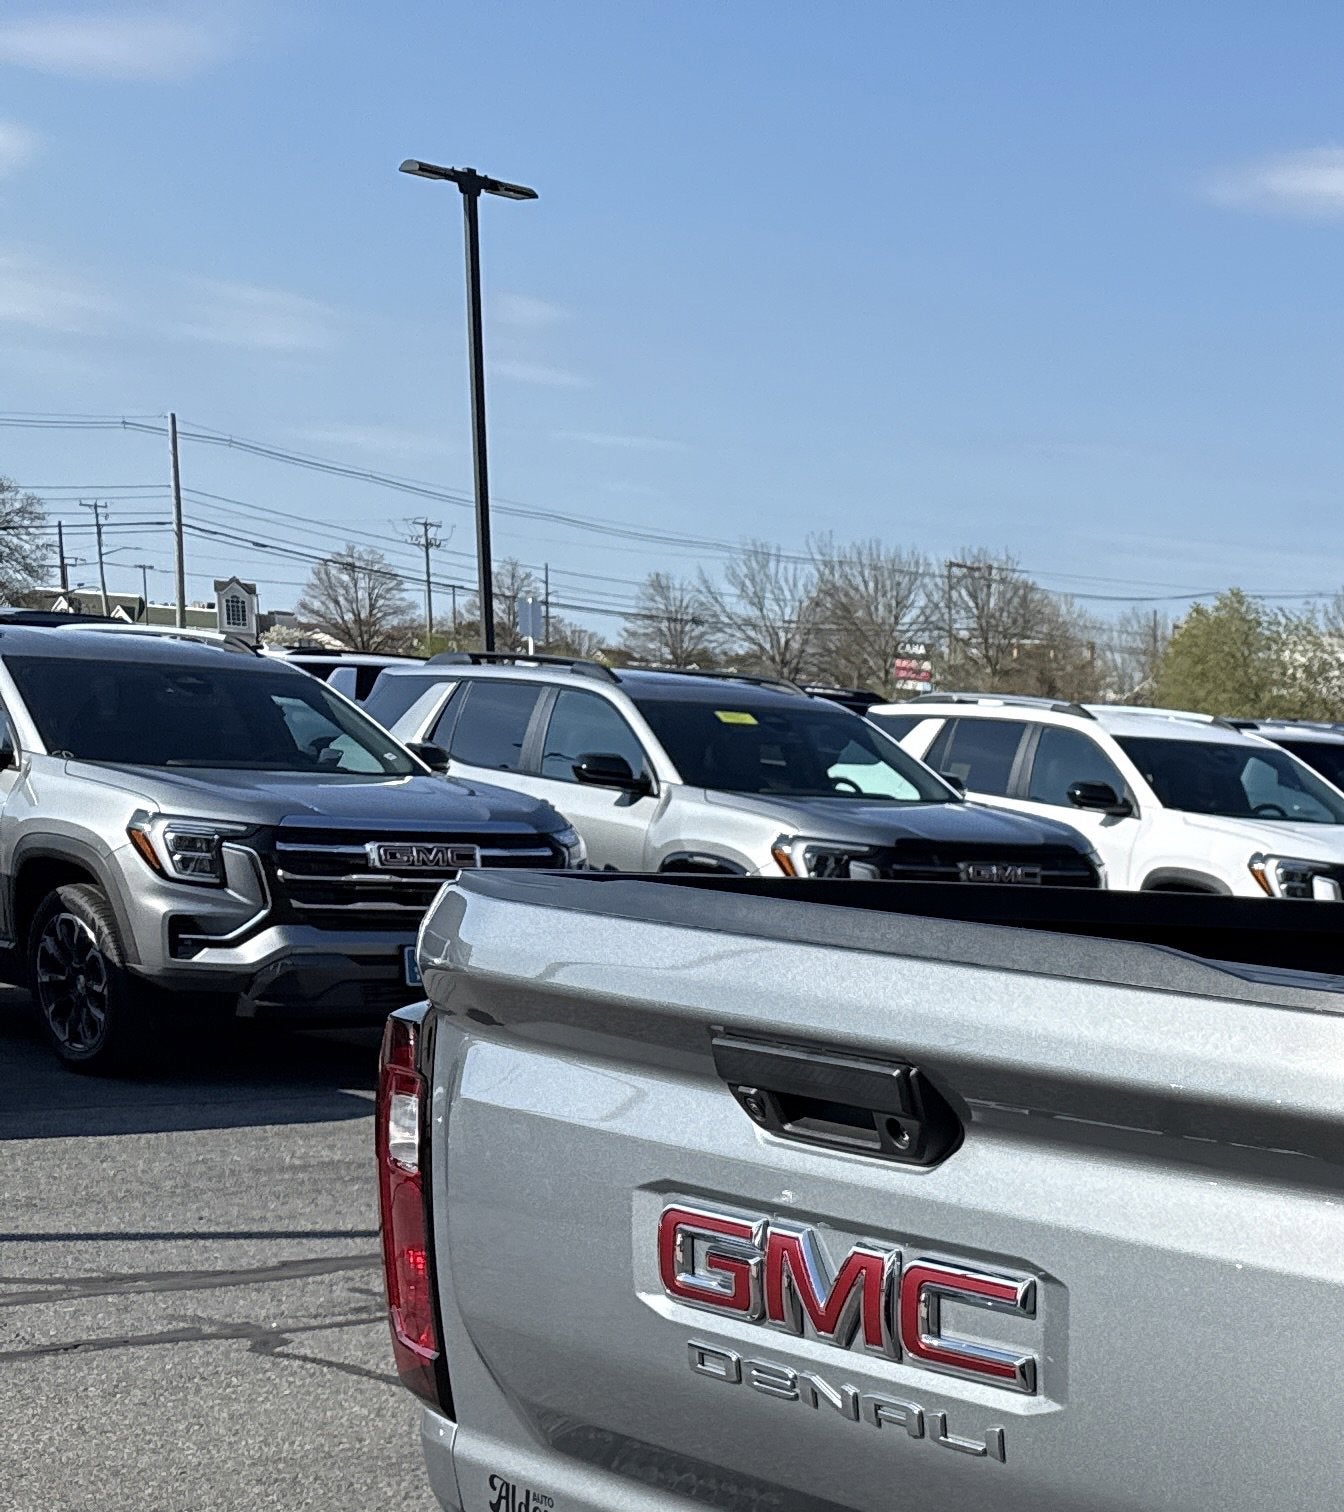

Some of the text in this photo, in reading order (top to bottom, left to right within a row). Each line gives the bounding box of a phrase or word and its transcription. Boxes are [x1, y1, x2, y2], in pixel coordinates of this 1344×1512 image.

[380, 845, 476, 867] GMC
[967, 864, 1041, 884] GMC
[657, 1194, 1038, 1396] GMC
[686, 1338, 1007, 1463] DENALI
[532, 1491, 554, 1509] AUTO
